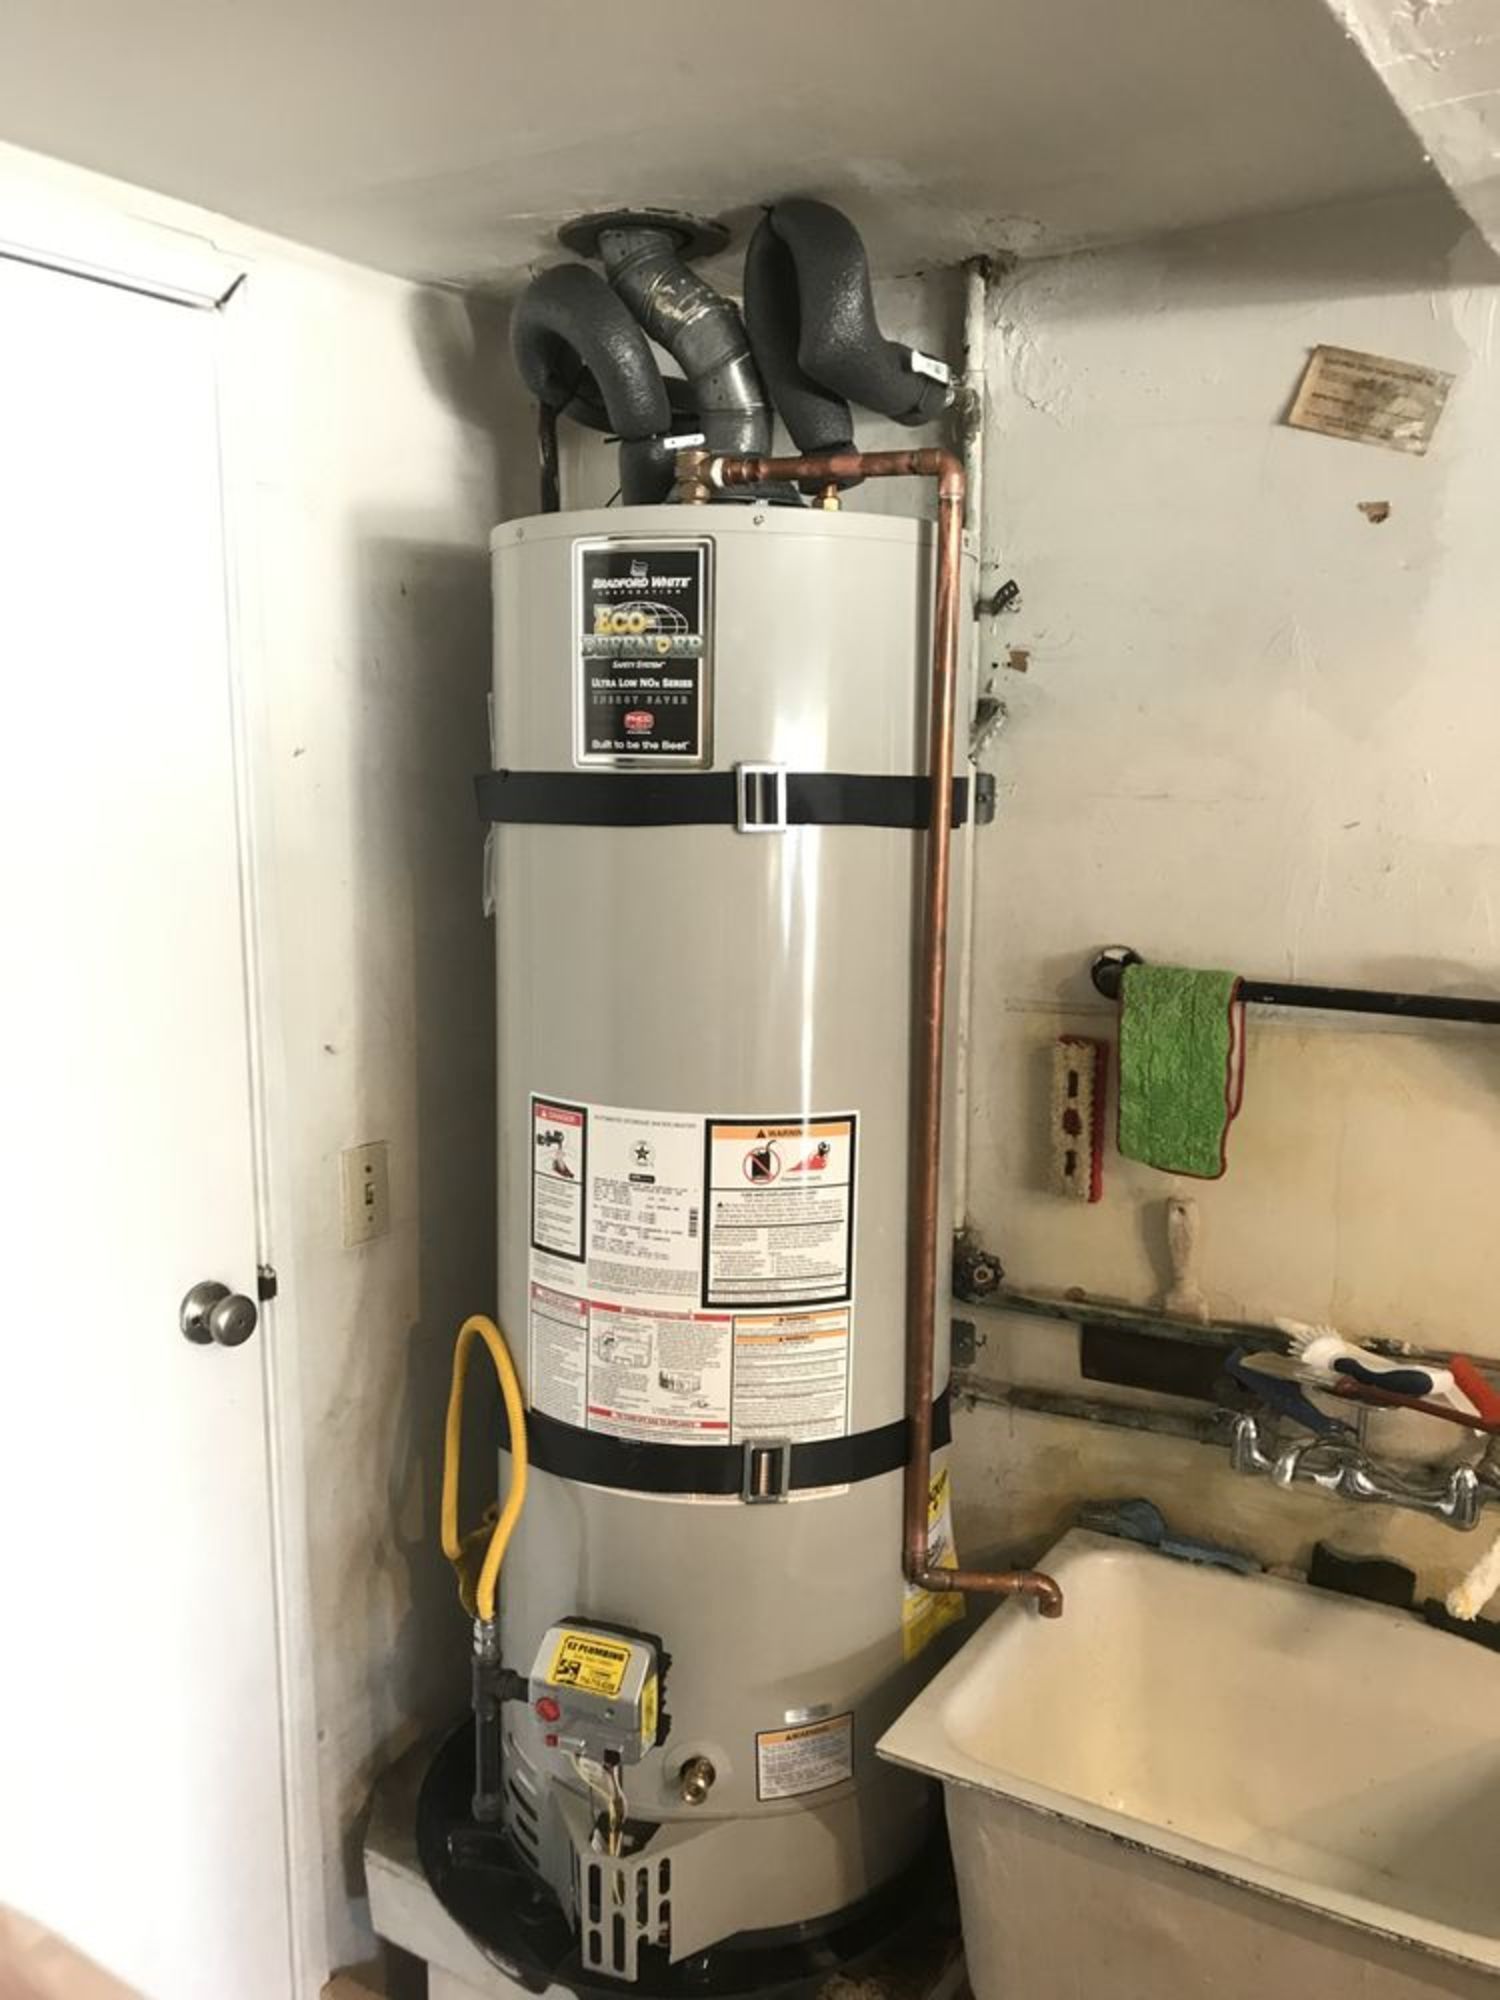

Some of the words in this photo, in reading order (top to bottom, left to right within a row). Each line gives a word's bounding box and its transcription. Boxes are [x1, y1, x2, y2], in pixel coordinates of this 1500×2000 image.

[592, 577, 649, 589] BRADFORD
[651, 576, 691, 588] WHITE
[591, 678, 617, 688] ULTRA
[619, 678, 638, 688] LOW
[662, 678, 694, 688] SERIES
[591, 740, 613, 750] Built
[614, 741, 625, 750] to
[626, 740, 640, 750] be
[642, 740, 659, 750] the
